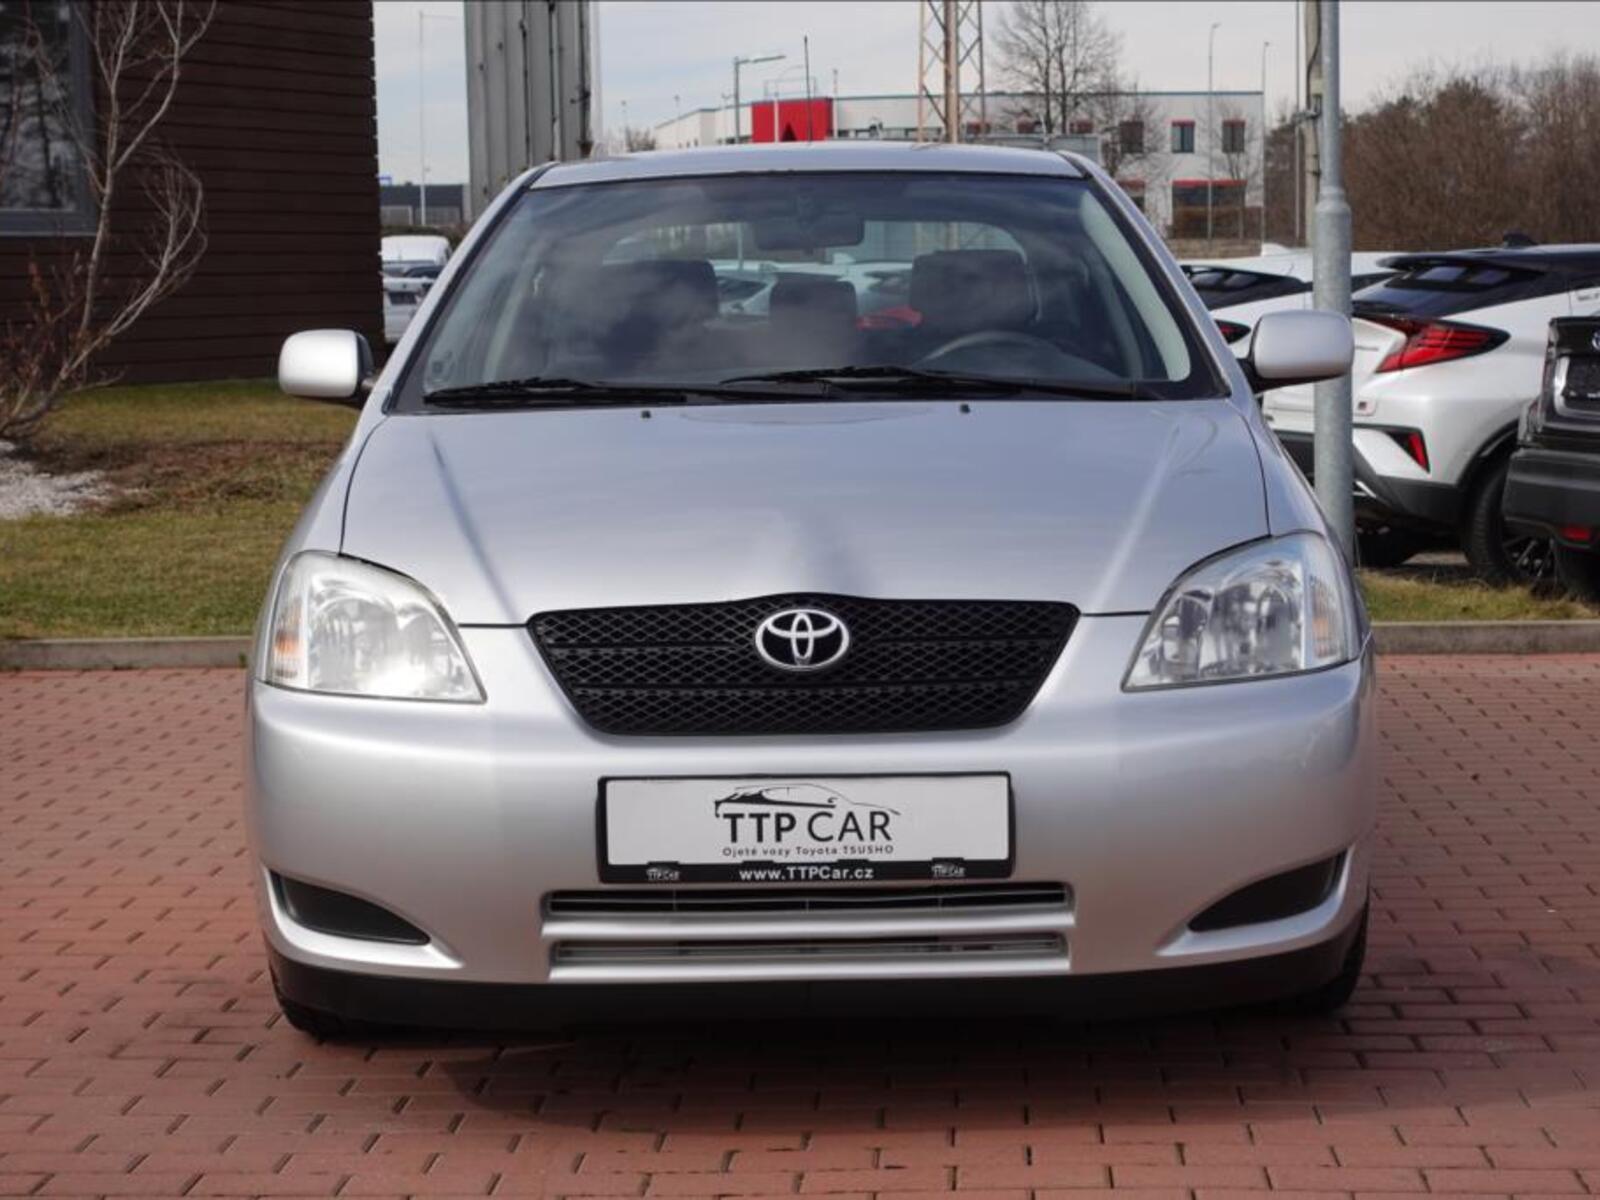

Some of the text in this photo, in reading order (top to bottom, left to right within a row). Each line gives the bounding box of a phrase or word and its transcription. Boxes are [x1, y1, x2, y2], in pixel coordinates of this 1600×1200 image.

[722, 811, 892, 843] TTP CAR
[763, 848, 791, 858] vozy
[796, 846, 838, 857] Toyota
[843, 844, 894, 855] TSUSHO
[739, 865, 874, 881] www.TTPCar.cz
